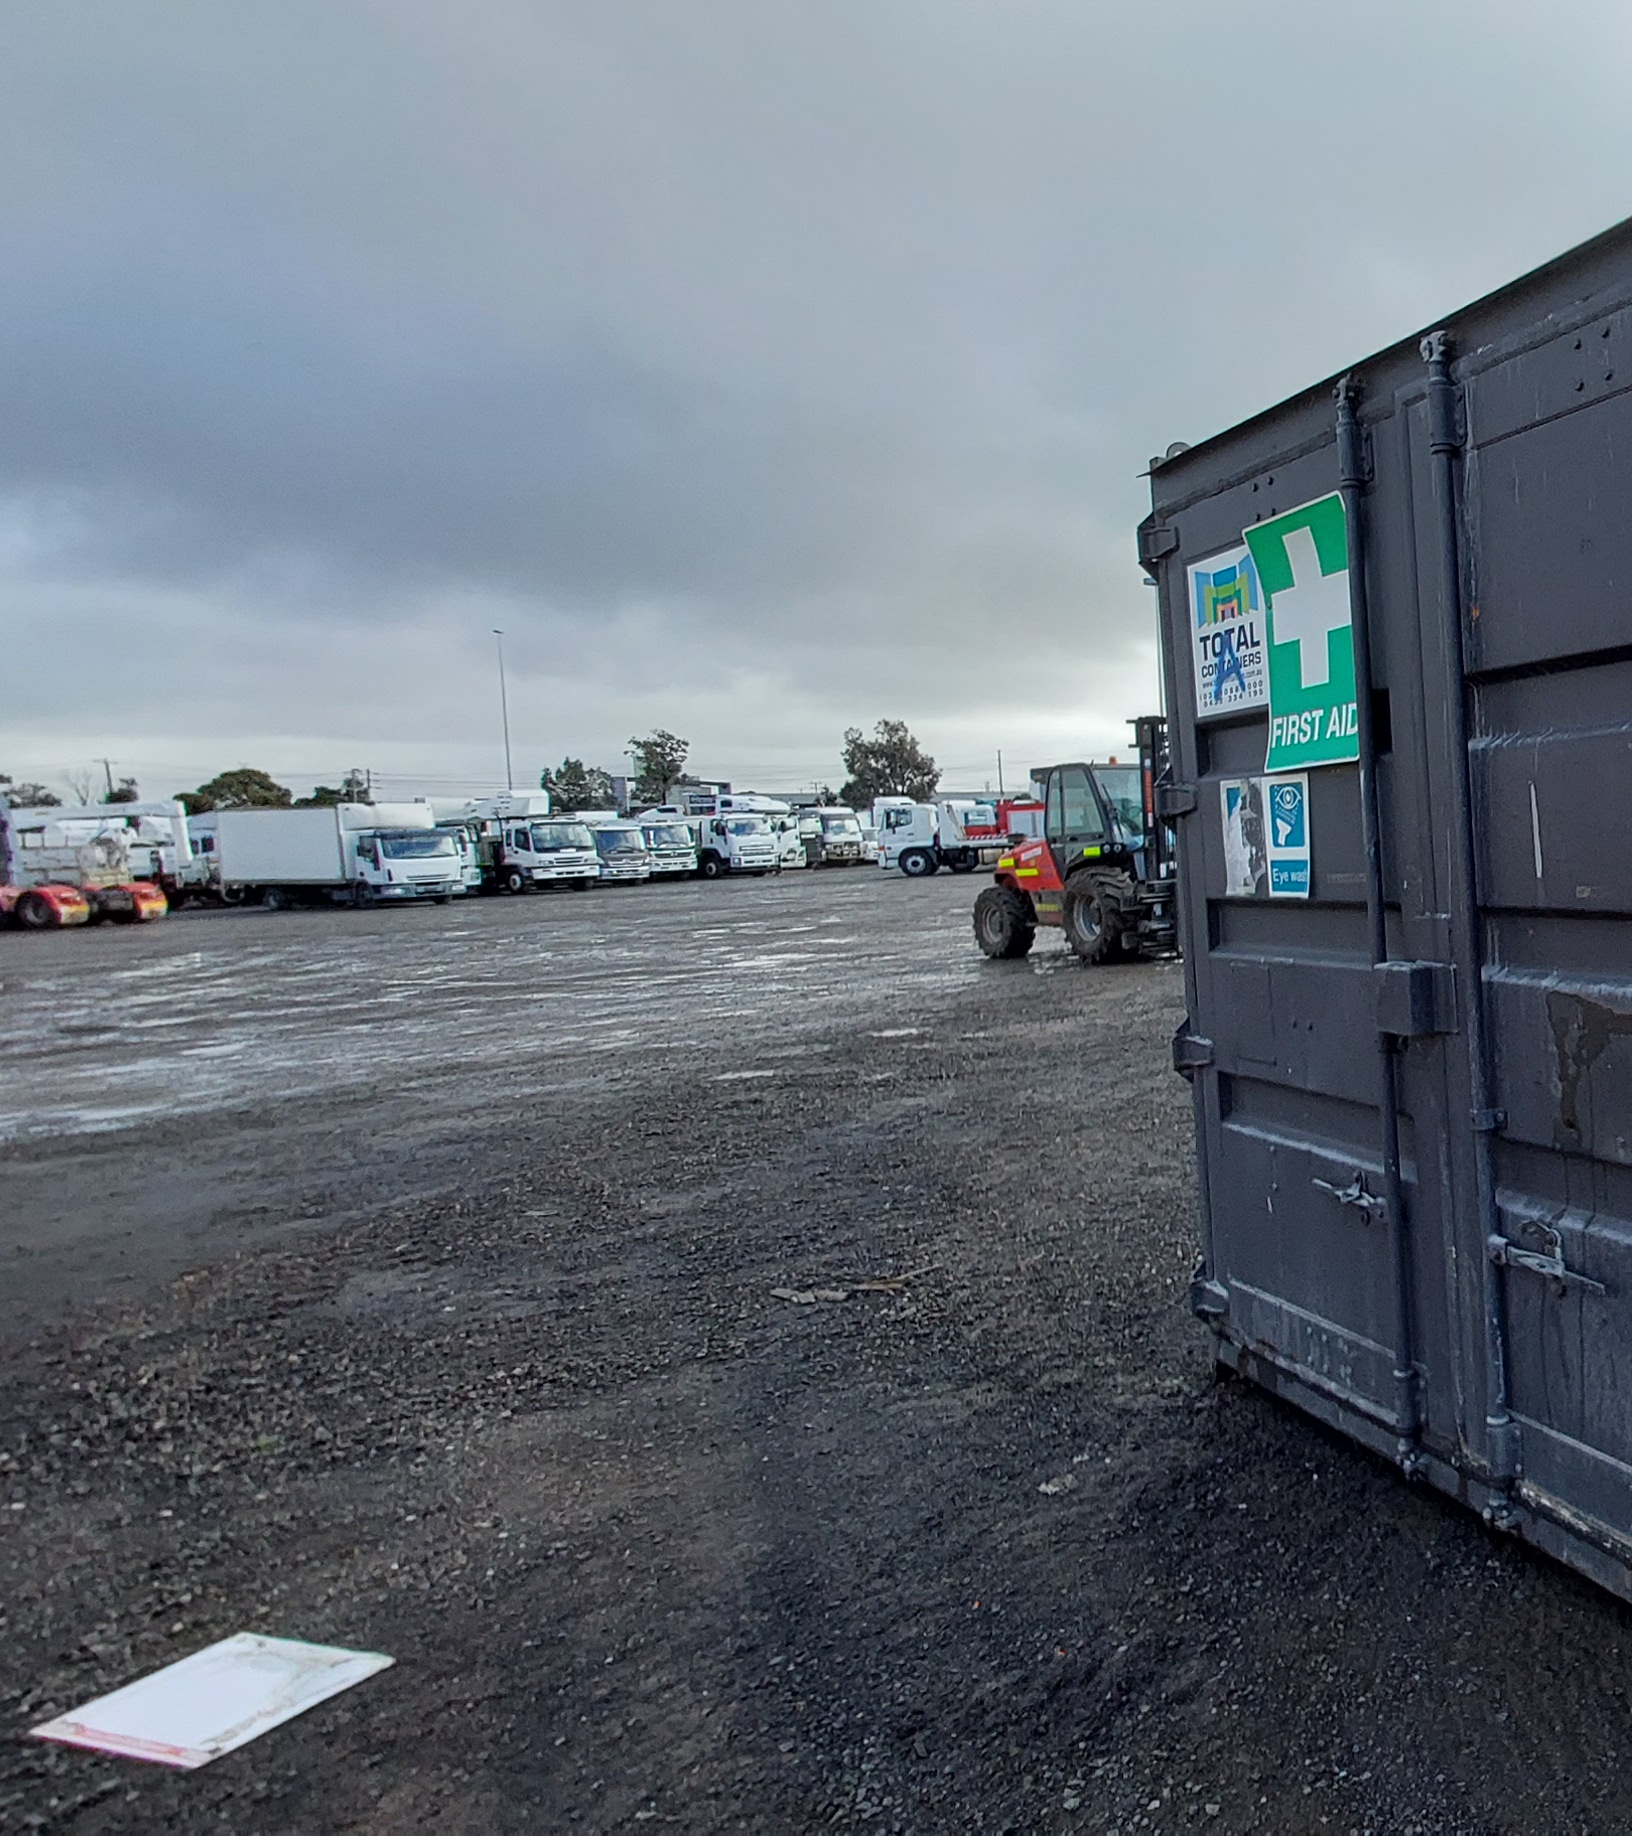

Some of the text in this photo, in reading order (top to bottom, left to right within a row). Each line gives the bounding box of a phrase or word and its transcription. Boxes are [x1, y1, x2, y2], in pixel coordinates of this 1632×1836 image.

[1199, 621, 1261, 661] TOTAL
[1228, 693, 1243, 703] 334
[1271, 702, 1358, 749] FIRST AID
[1272, 868, 1289, 885] Eye
